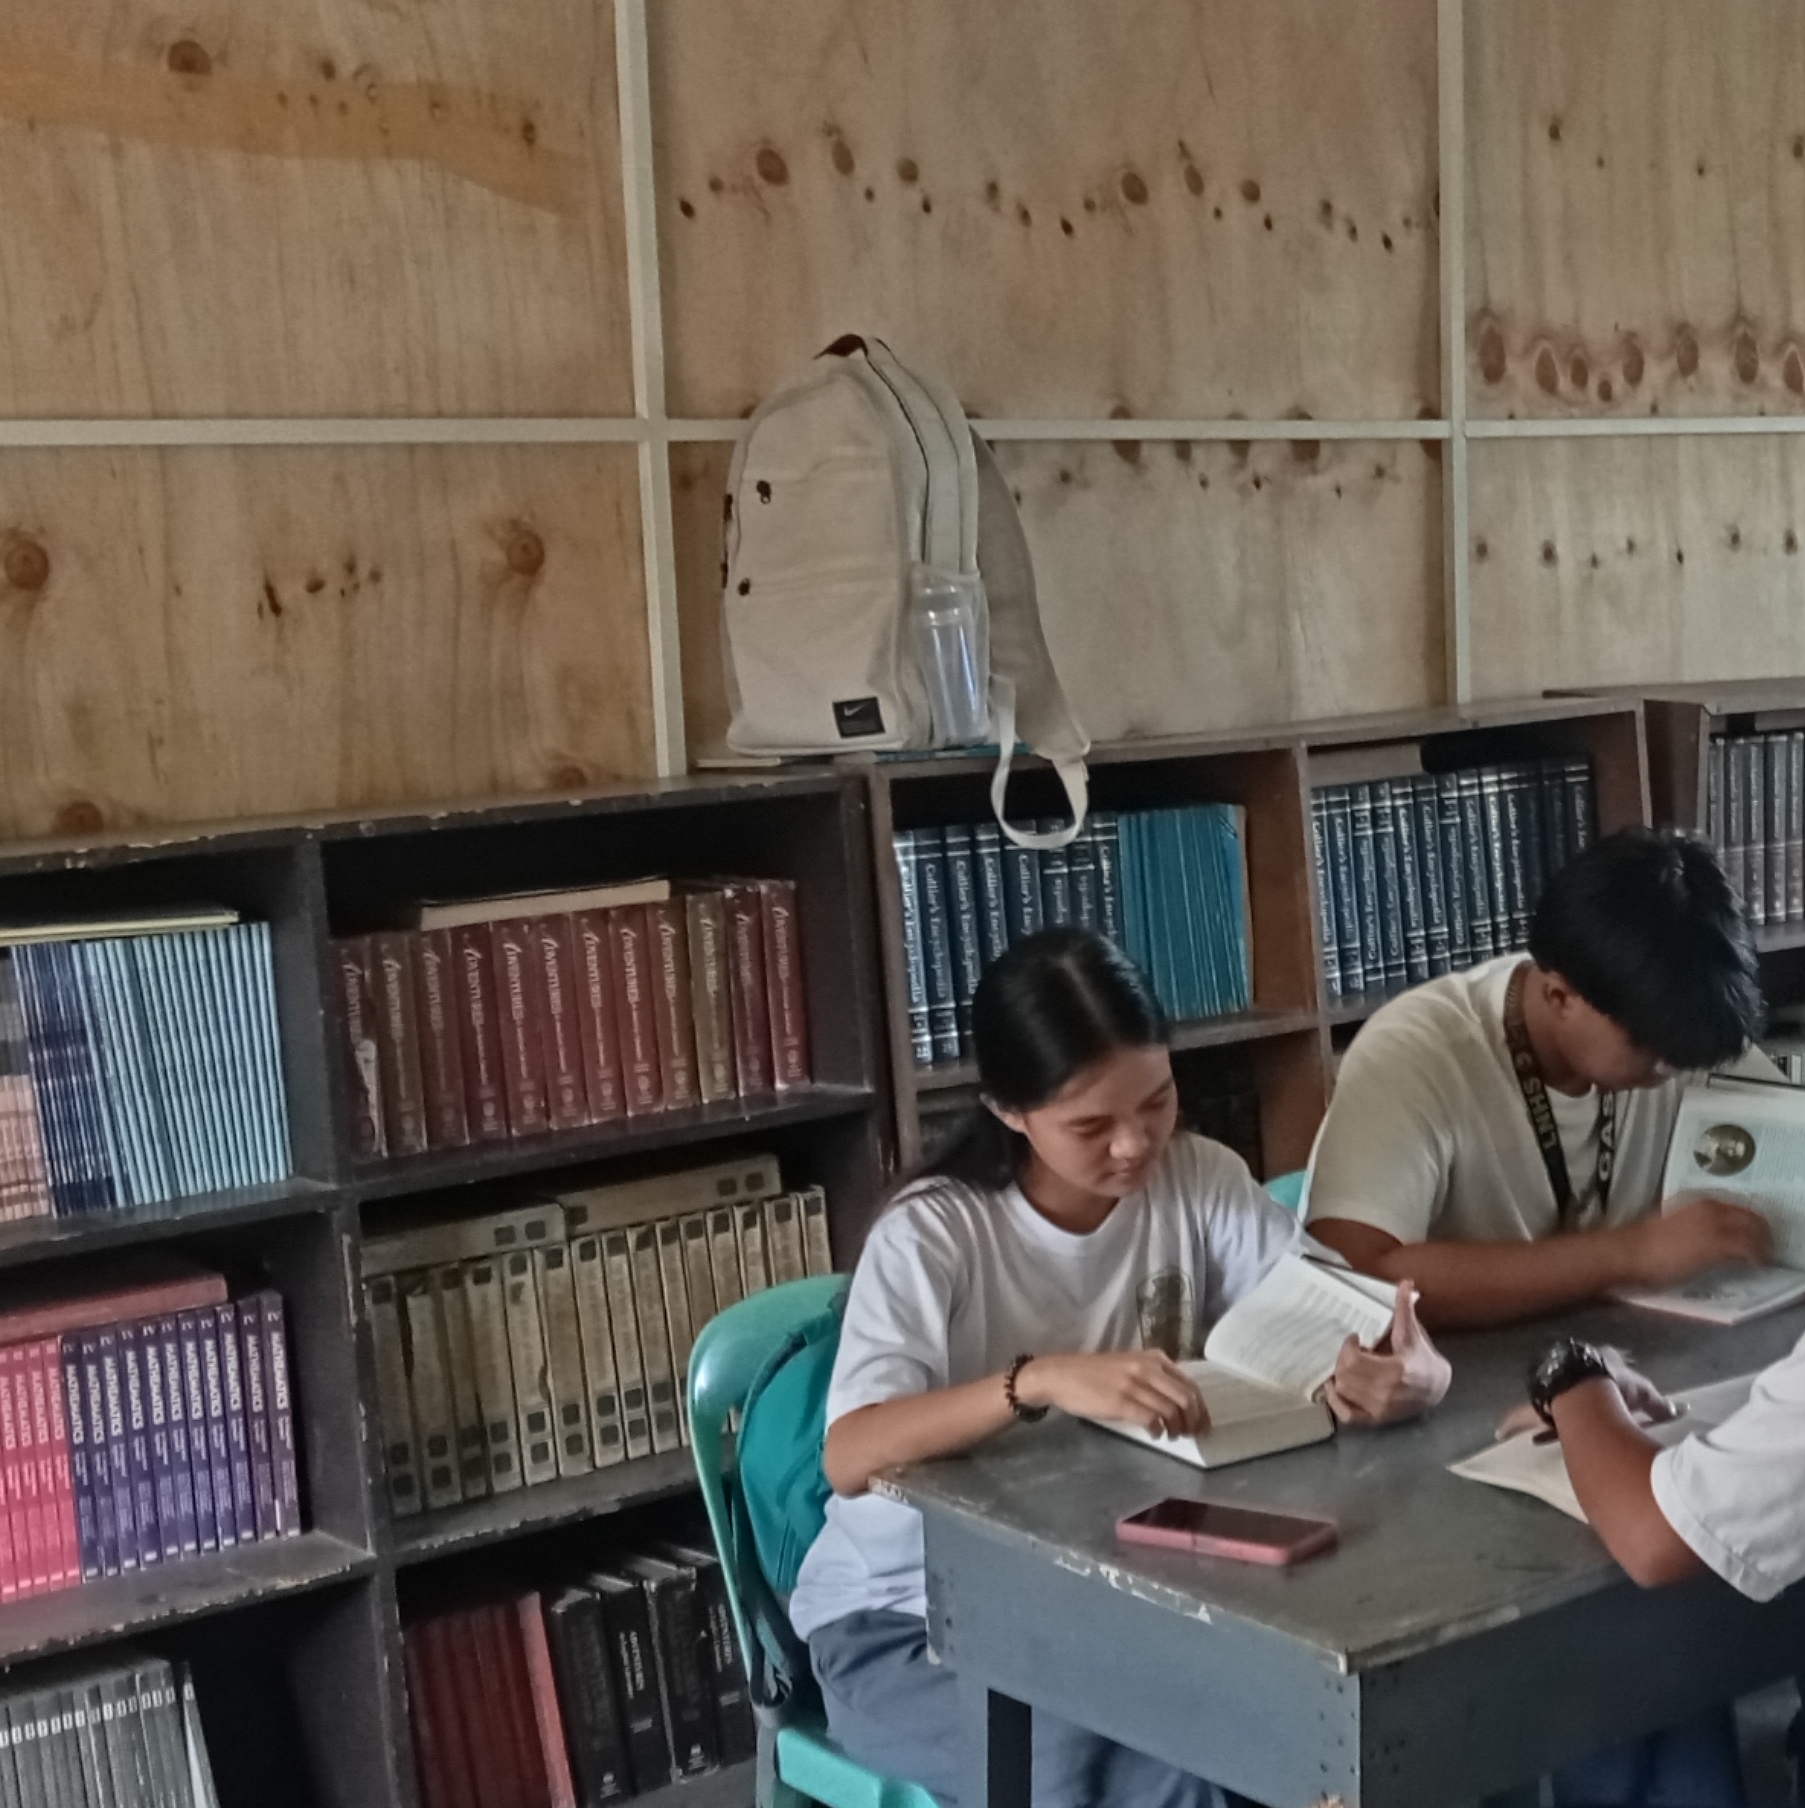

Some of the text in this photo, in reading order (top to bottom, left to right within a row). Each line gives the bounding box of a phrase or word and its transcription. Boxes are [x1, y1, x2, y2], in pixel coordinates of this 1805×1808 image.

[66, 1364, 84, 1444] MATHEMATICS
[86, 1364, 104, 1444] MATHEMATICS
[104, 1355, 122, 1437] MATHEMATICS
[125, 1350, 143, 1430] MATHEMATICS
[146, 1345, 164, 1425] MATHEMATICS
[165, 1343, 182, 1422] MATHEMATICS
[184, 1341, 202, 1420] MATHEMATICS
[204, 1339, 222, 1417] MATHEMATICS
[224, 1333, 242, 1411] MATHEMATICS
[246, 1334, 263, 1412] MATHEMATICS
[270, 1331, 288, 1409] MATHEMATICS
